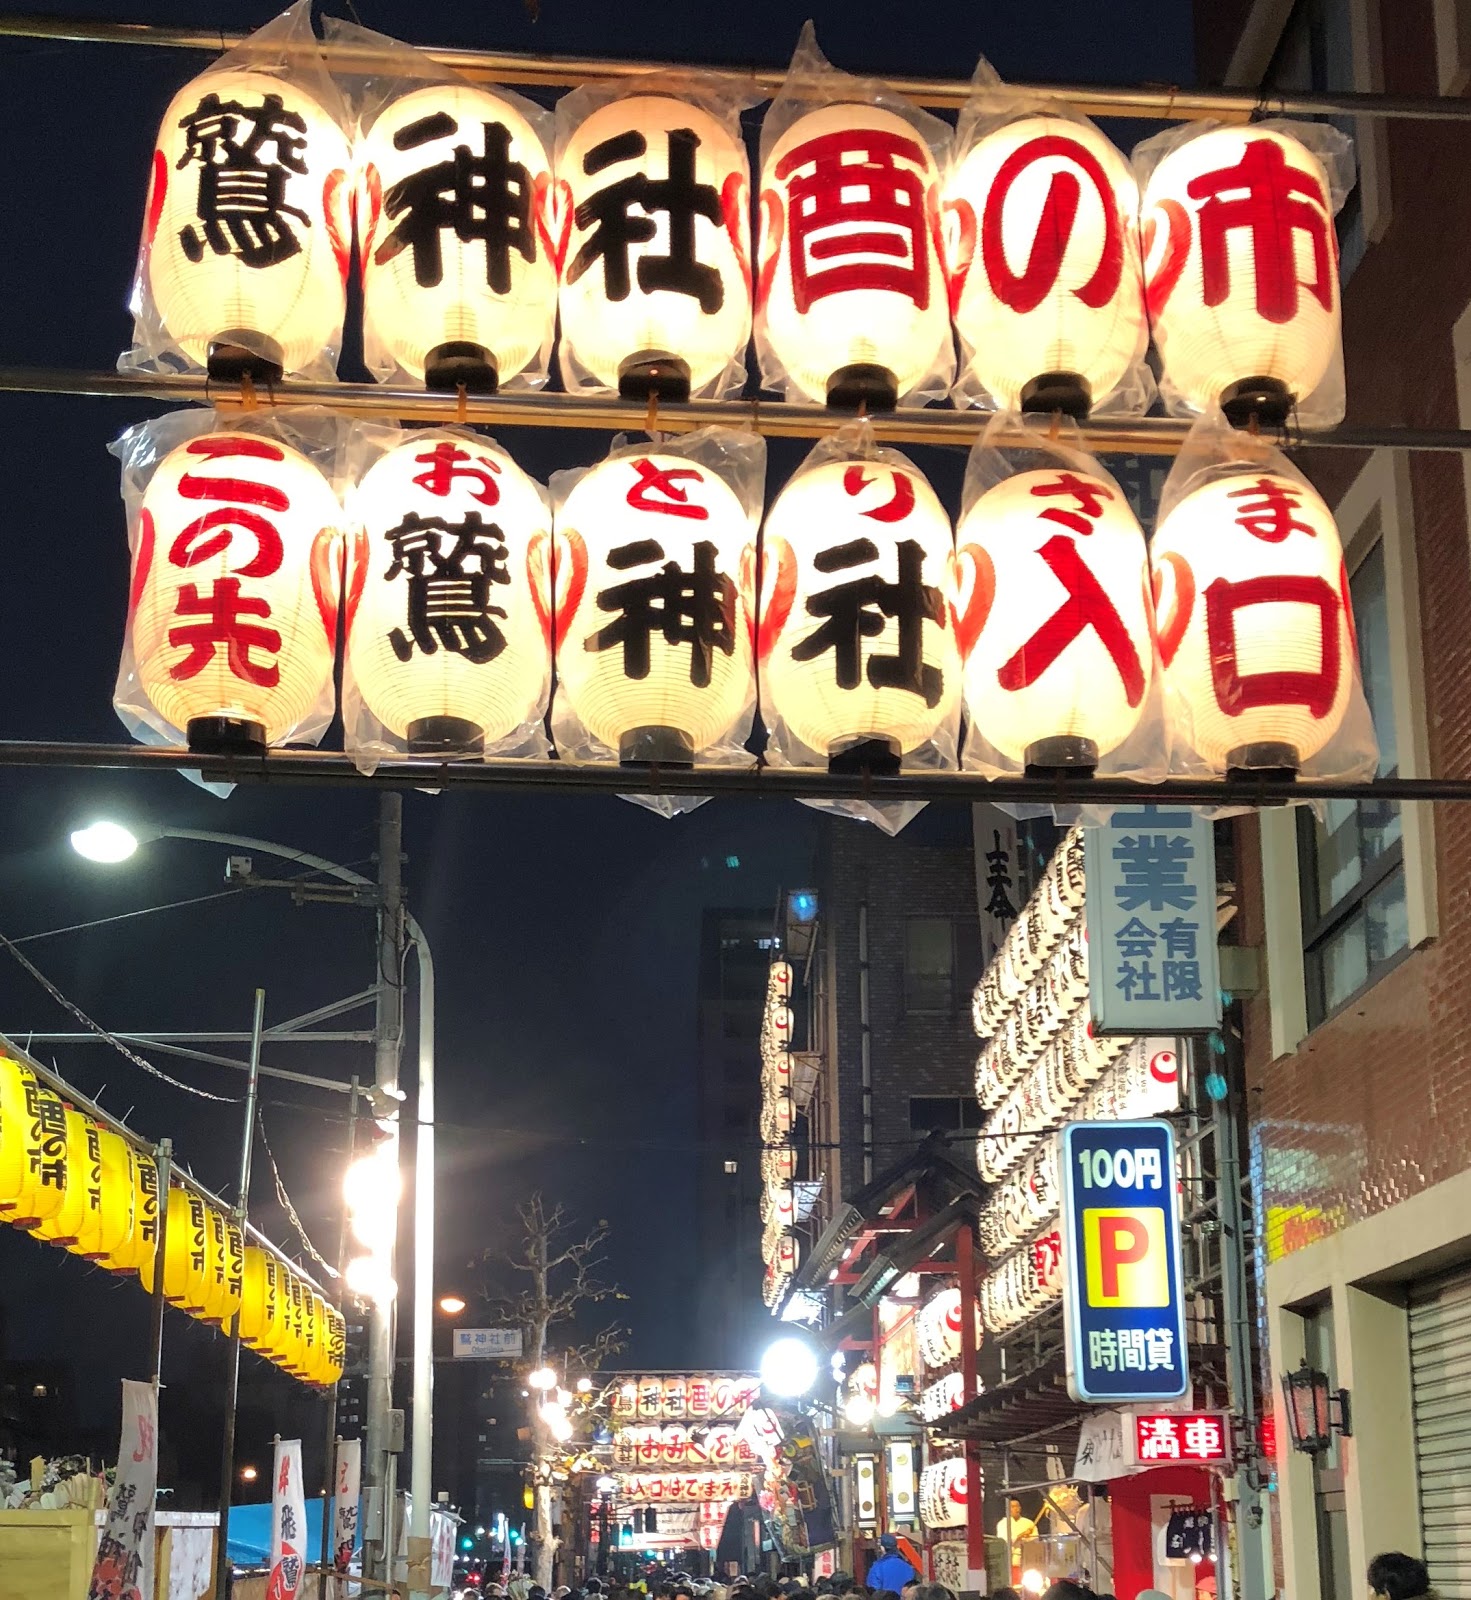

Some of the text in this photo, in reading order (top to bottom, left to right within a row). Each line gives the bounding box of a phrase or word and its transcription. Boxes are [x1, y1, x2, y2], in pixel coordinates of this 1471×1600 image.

[1078, 1148, 1163, 1190] 100円
[1097, 1216, 1150, 1298] P
[1088, 1327, 1175, 1372] 時間貸
[1139, 1417, 1223, 1459] 満車
